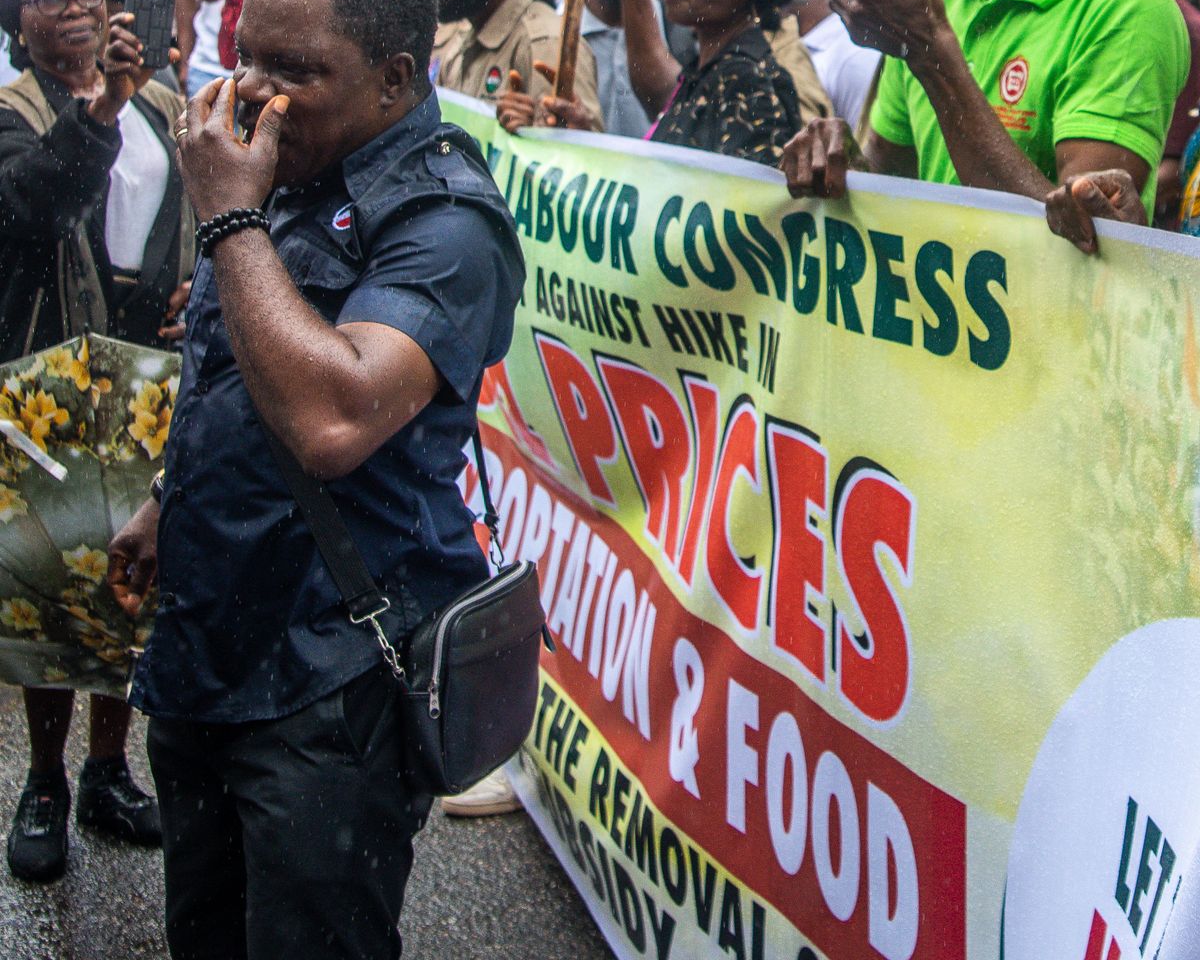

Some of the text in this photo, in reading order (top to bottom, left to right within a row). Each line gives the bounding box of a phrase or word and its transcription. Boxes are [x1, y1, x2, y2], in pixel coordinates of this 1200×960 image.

[536, 266, 781, 395] AGAINST HIKE IN
[654, 194, 1012, 372] CONGRESS
[529, 326, 918, 729] PRICES
[535, 681, 767, 960] THE REMOVAL
[668, 637, 702, 800] &
[726, 677, 921, 960] FOOD
